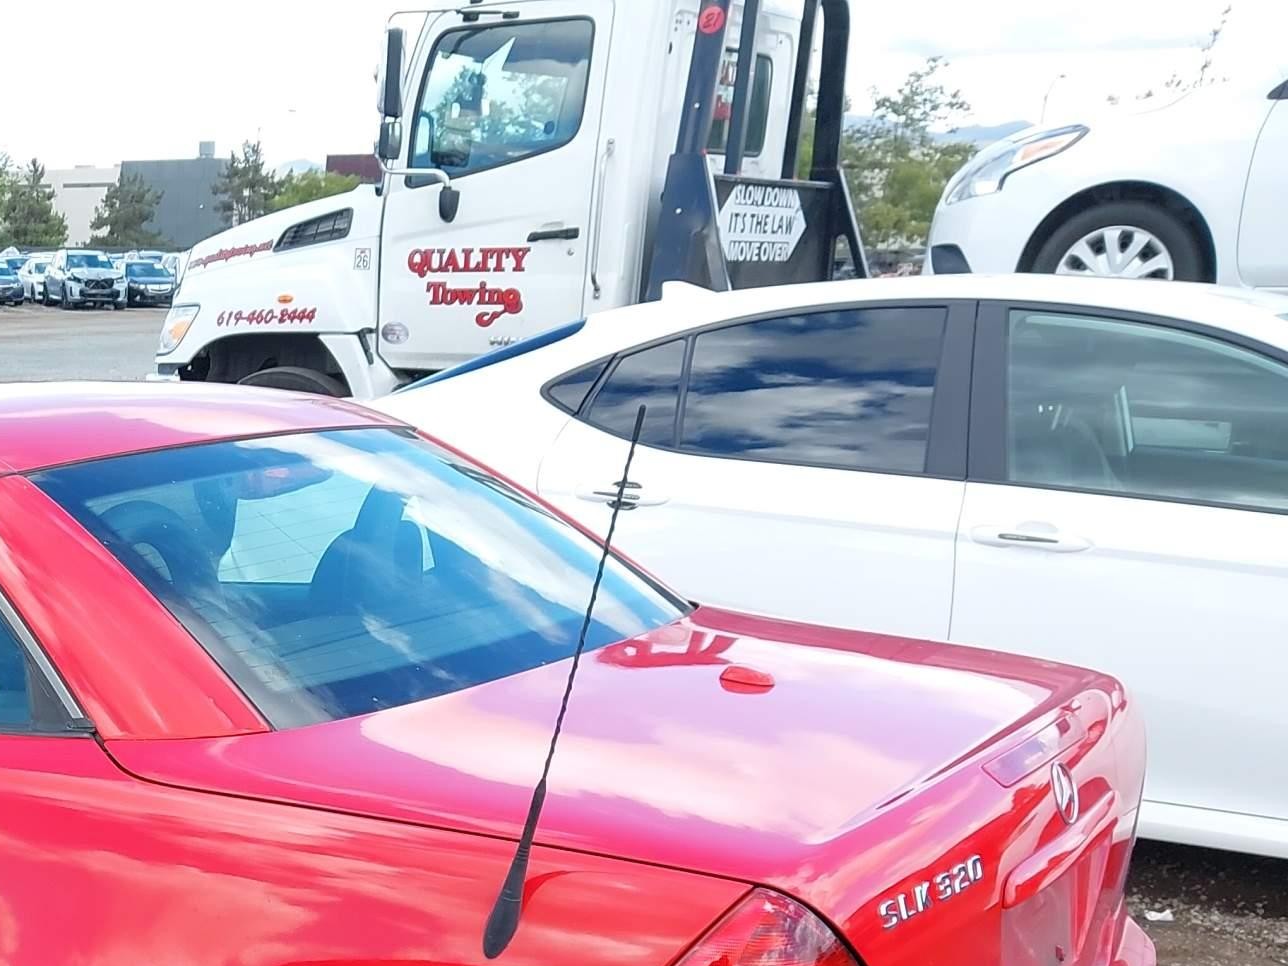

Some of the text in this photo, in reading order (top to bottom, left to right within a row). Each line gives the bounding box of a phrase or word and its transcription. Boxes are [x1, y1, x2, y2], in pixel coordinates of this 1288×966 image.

[736, 184, 796, 208] SLOW DOWN
[750, 213, 769, 234] THE
[771, 215, 793, 235] LAW
[357, 254, 369, 268] 26
[728, 240, 789, 261] MOVE OVER
[408, 247, 531, 278] QUALITY
[426, 281, 523, 327] Towing
[217, 307, 317, 326] 619-460-2444
[878, 854, 984, 930] SLK 320
